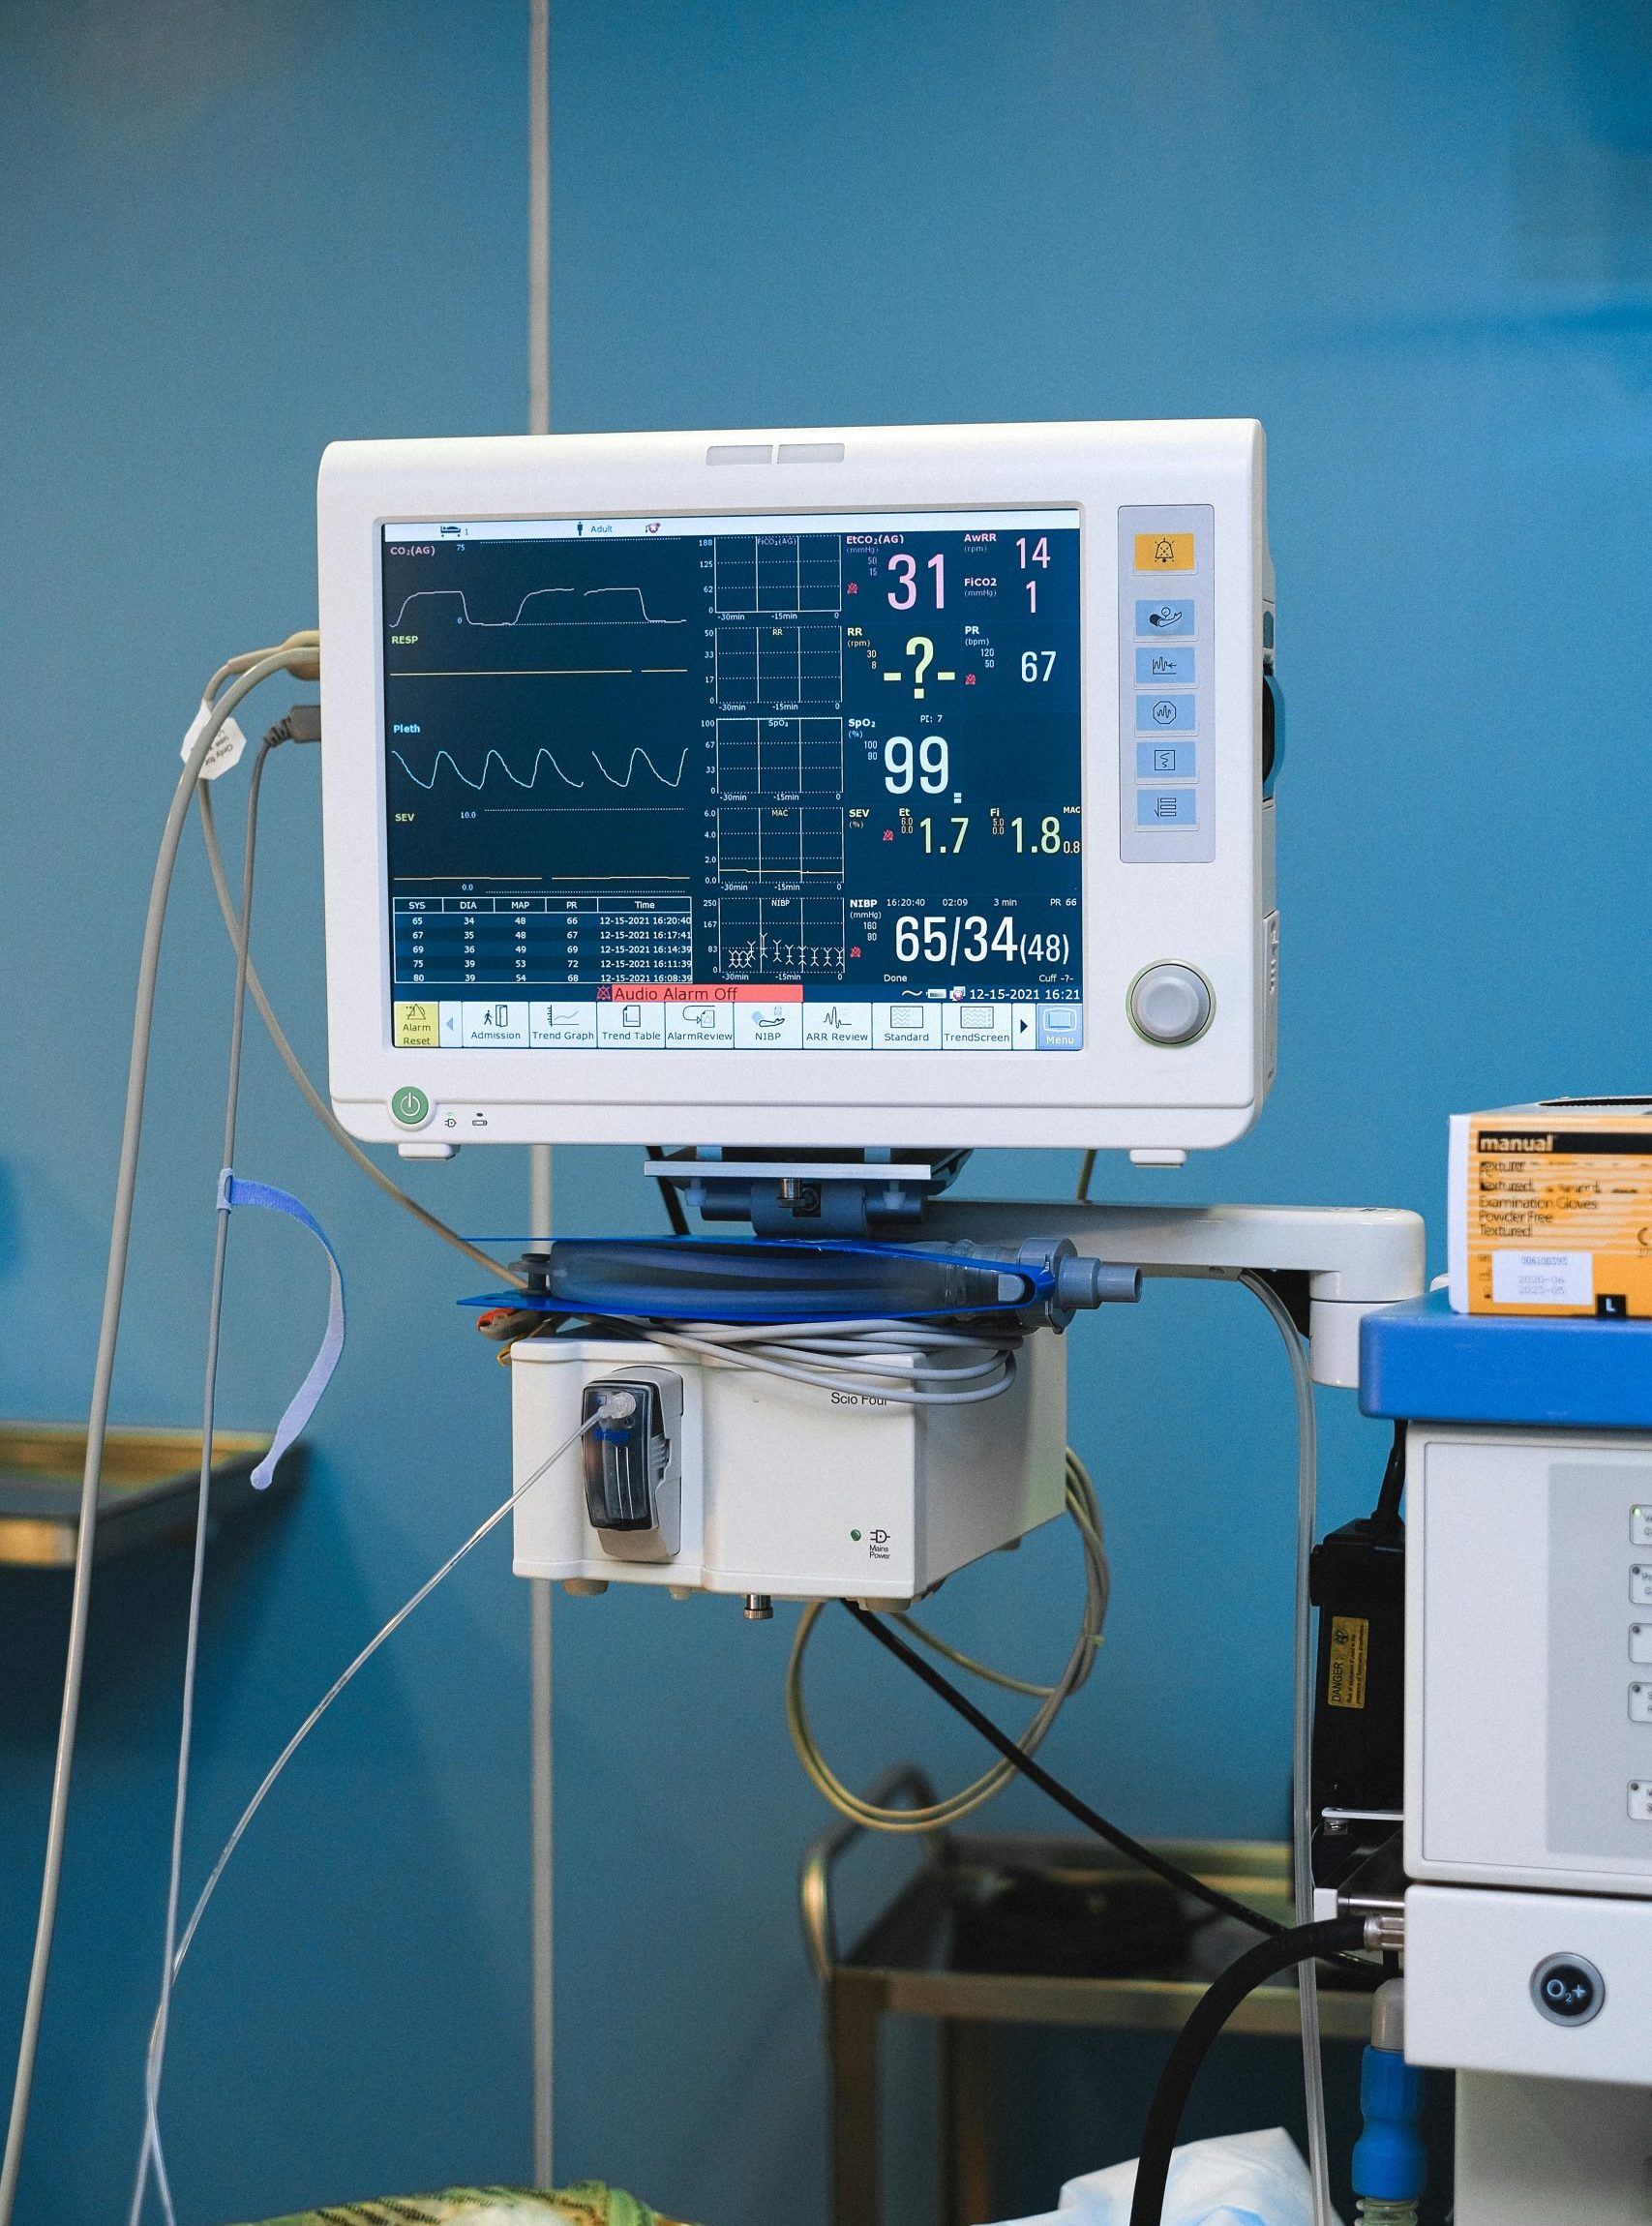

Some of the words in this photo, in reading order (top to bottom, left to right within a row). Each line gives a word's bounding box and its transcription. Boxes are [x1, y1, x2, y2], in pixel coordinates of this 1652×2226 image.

[590, 524, 613, 533] Adult
[964, 533, 997, 542] AwRR
[846, 546, 879, 555] (mmHg)
[1016, 537, 1051, 569] 14
[887, 553, 945, 611] 31
[964, 578, 998, 587] FiCO2
[1026, 580, 1036, 614] 1
[847, 627, 862, 636] RR
[965, 626, 979, 635] PR
[391, 635, 418, 645] RESP
[847, 639, 871, 647] (rpm)
[965, 637, 989, 647] (bpm)
[867, 649, 877, 659] 30
[980, 648, 995, 657] 120
[984, 659, 995, 669] 50
[1020, 650, 1057, 683] 67
[393, 723, 421, 734] Pleth
[864, 740, 878, 749] 100
[885, 736, 949, 795] 99
[849, 808, 870, 817] SEV
[899, 808, 911, 817] Et
[990, 807, 1000, 817] Fi
[395, 813, 415, 822] SEV
[919, 817, 969, 854] 1.7
[1011, 816, 1061, 854] 1.8
[1063, 841, 1080, 854] 0.8
[408, 901, 426, 910] SYS
[460, 901, 477, 910] DIA
[511, 901, 530, 910] MAP
[635, 900, 655, 909] Time
[850, 899, 878, 908] NIBP
[886, 898, 926, 907] 16:20:40
[412, 931, 424, 940] 67
[464, 931, 474, 940] 35
[515, 931, 526, 940] 48
[567, 931, 578, 940] 67
[600, 931, 650, 940] 12-15-2021
[653, 931, 692, 940] 16:17:41
[413, 974, 424, 982] 80
[465, 974, 475, 982] 39
[516, 974, 526, 982] 54
[567, 974, 579, 982] 68
[601, 974, 650, 982] 12-15-2021
[653, 974, 692, 982] 16:08:39
[615, 987, 657, 1001] Audio
[664, 987, 707, 1001] Alarm
[714, 987, 738, 1001] Off
[970, 990, 1039, 1000] 12-15-2021
[1045, 990, 1080, 1000] 16:21
[403, 1023, 432, 1032] Alarm
[471, 1031, 521, 1039] Admission
[532, 1031, 560, 1040] Trend
[564, 1031, 594, 1042] Graph
[602, 1032, 632, 1040] Trend
[636, 1032, 661, 1040] Table
[668, 1032, 733, 1040] AlarmReview
[885, 1033, 929, 1041] Standard
[945, 1033, 1009, 1042] TrendScreen
[403, 1037, 431, 1045] Reset
[1046, 1036, 1074, 1044] Menu
[1480, 1135, 1553, 1152] manual
[1479, 1196, 1553, 1209] Examination
[1556, 1196, 1597, 1209] Gloves
[1479, 1211, 1525, 1222] Powder
[1528, 1211, 1553, 1223] Free
[1480, 1225, 1531, 1237] Textured
[1606, 1298, 1615, 1311] L
[831, 1393, 857, 1405] Scio
